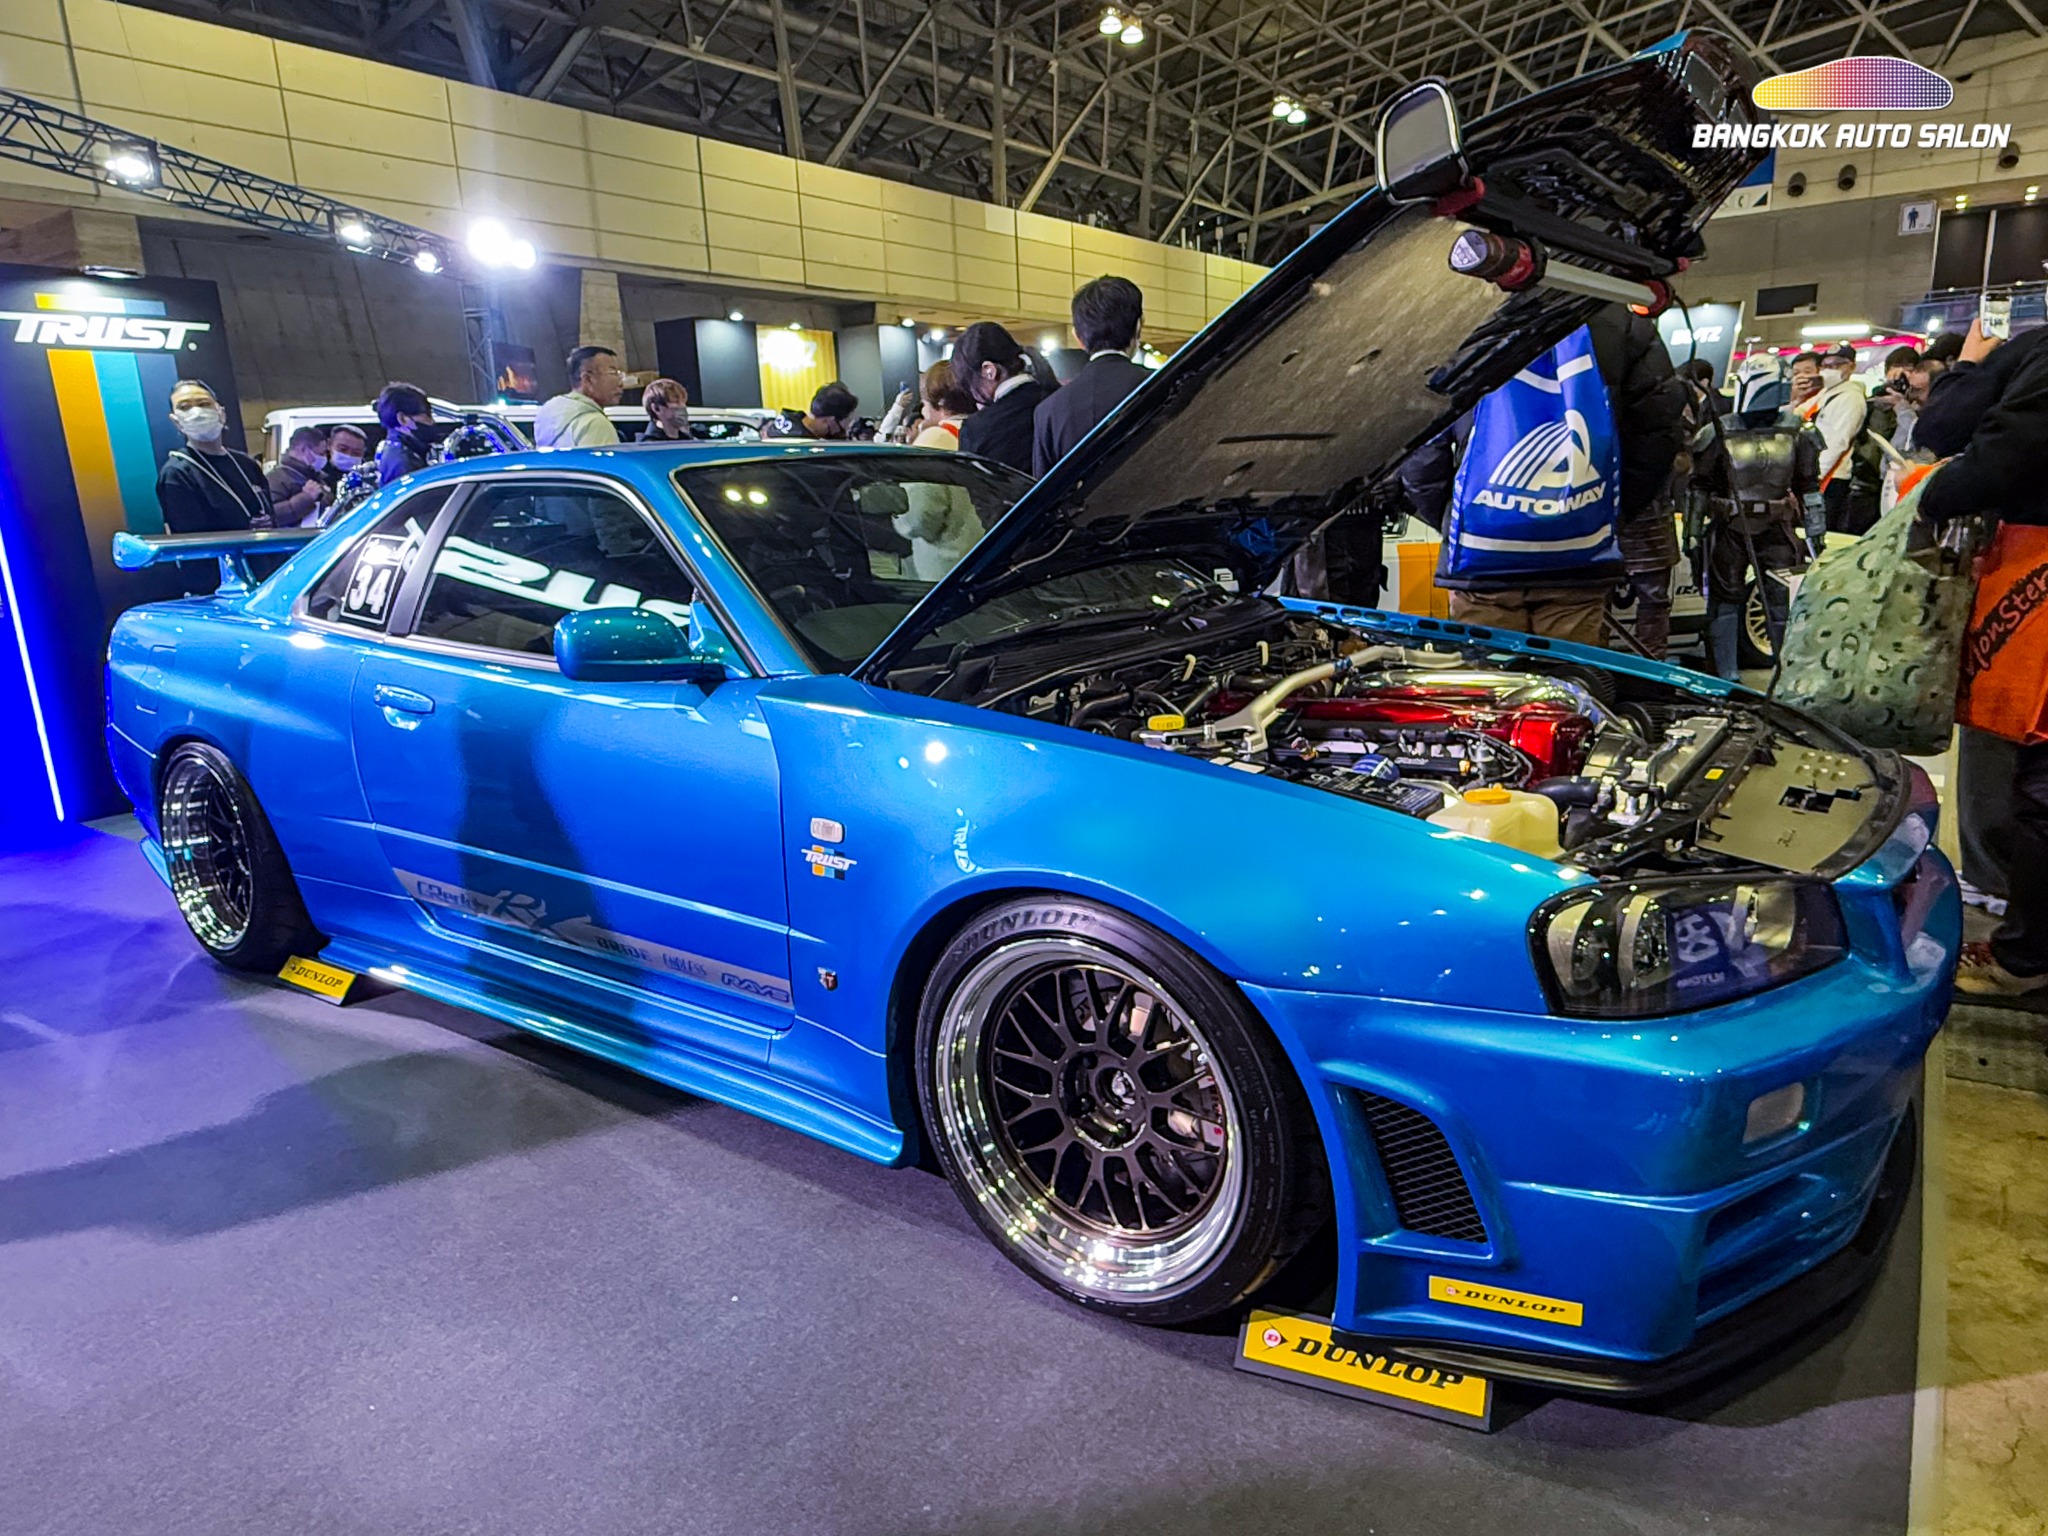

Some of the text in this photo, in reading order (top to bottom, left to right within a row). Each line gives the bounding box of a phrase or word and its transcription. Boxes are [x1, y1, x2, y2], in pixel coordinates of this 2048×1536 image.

[1473, 481, 1606, 515] AUTOWAY
[348, 564, 393, 615] 34
[801, 848, 858, 871] TRUST
[964, 908, 1097, 953] DUNLOP
[295, 966, 344, 988] DUNLOP
[721, 972, 790, 1003] RAYS
[1464, 1290, 1566, 1314] DUNLOP
[1291, 1336, 1464, 1389] DUNLOP
